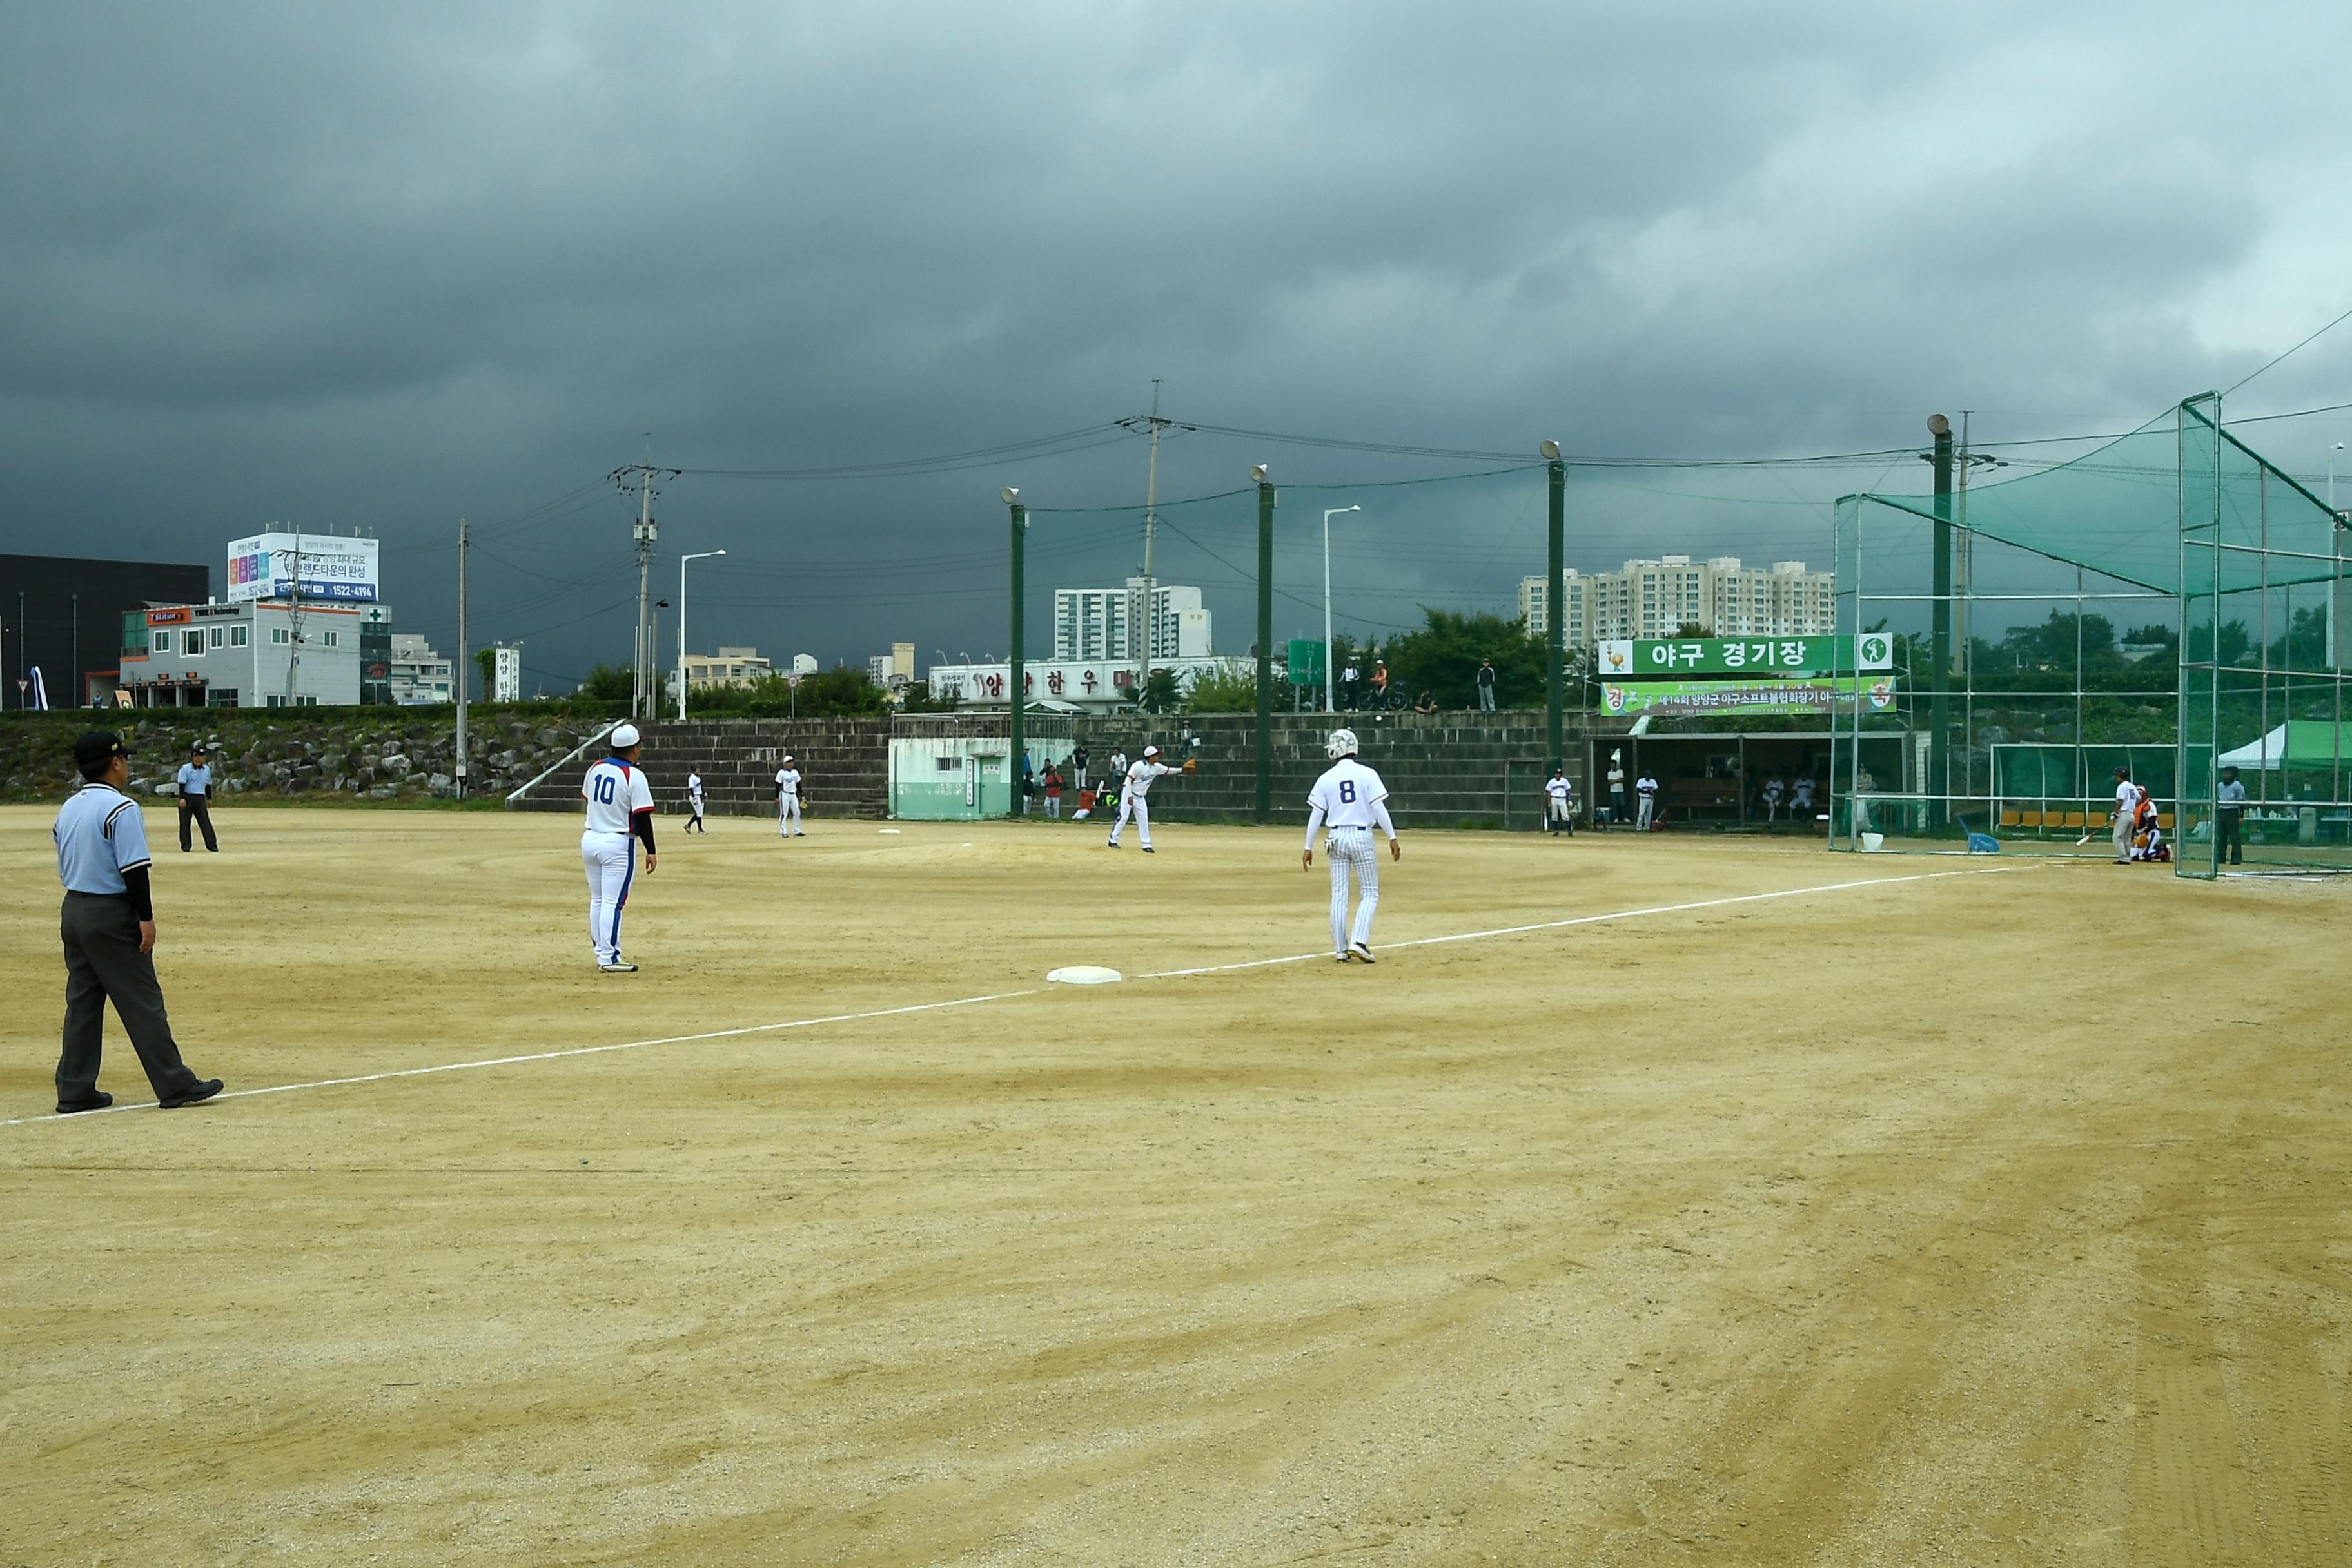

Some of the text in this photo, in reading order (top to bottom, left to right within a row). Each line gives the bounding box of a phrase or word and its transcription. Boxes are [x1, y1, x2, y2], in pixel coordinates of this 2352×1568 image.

[352, 556, 366, 565] 규모
[349, 566, 366, 578] 완성
[333, 585, 372, 597] 1522-4194
[155, 612, 176, 621] Station
[1652, 640, 1807, 668] 야구 경기장
[500, 652, 509, 676] 양양
[1609, 690, 1622, 708] 경
[1659, 694, 1689, 706] 제14회
[1691, 693, 1720, 706] 양양군
[1721, 691, 1818, 705] 야구소프트볼협회장기
[594, 774, 616, 805] 10
[1339, 779, 1357, 804] 8
